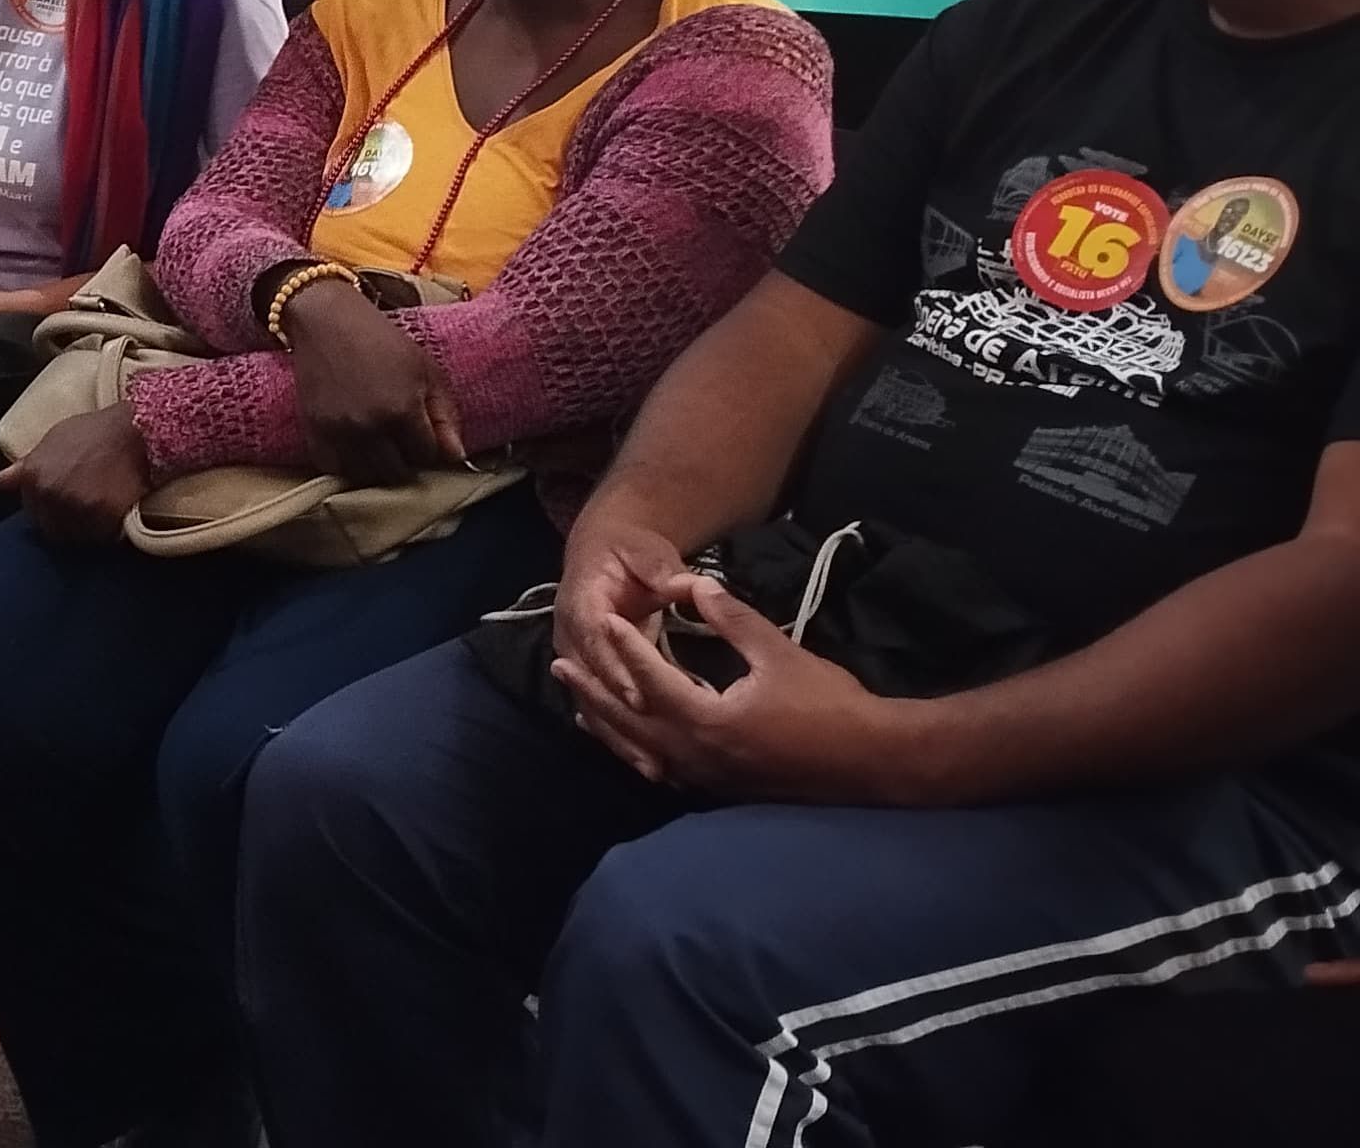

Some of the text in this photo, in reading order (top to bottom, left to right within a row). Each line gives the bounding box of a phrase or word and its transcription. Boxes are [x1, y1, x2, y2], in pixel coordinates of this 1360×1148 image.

[15, 80, 53, 101] que
[16, 105, 54, 127] que
[10, 139, 23, 154] e
[1094, 201, 1129, 223] VOTE
[1047, 205, 1142, 279] 16
[1217, 235, 1275, 272] 16123
[1060, 260, 1090, 279] PSTU
